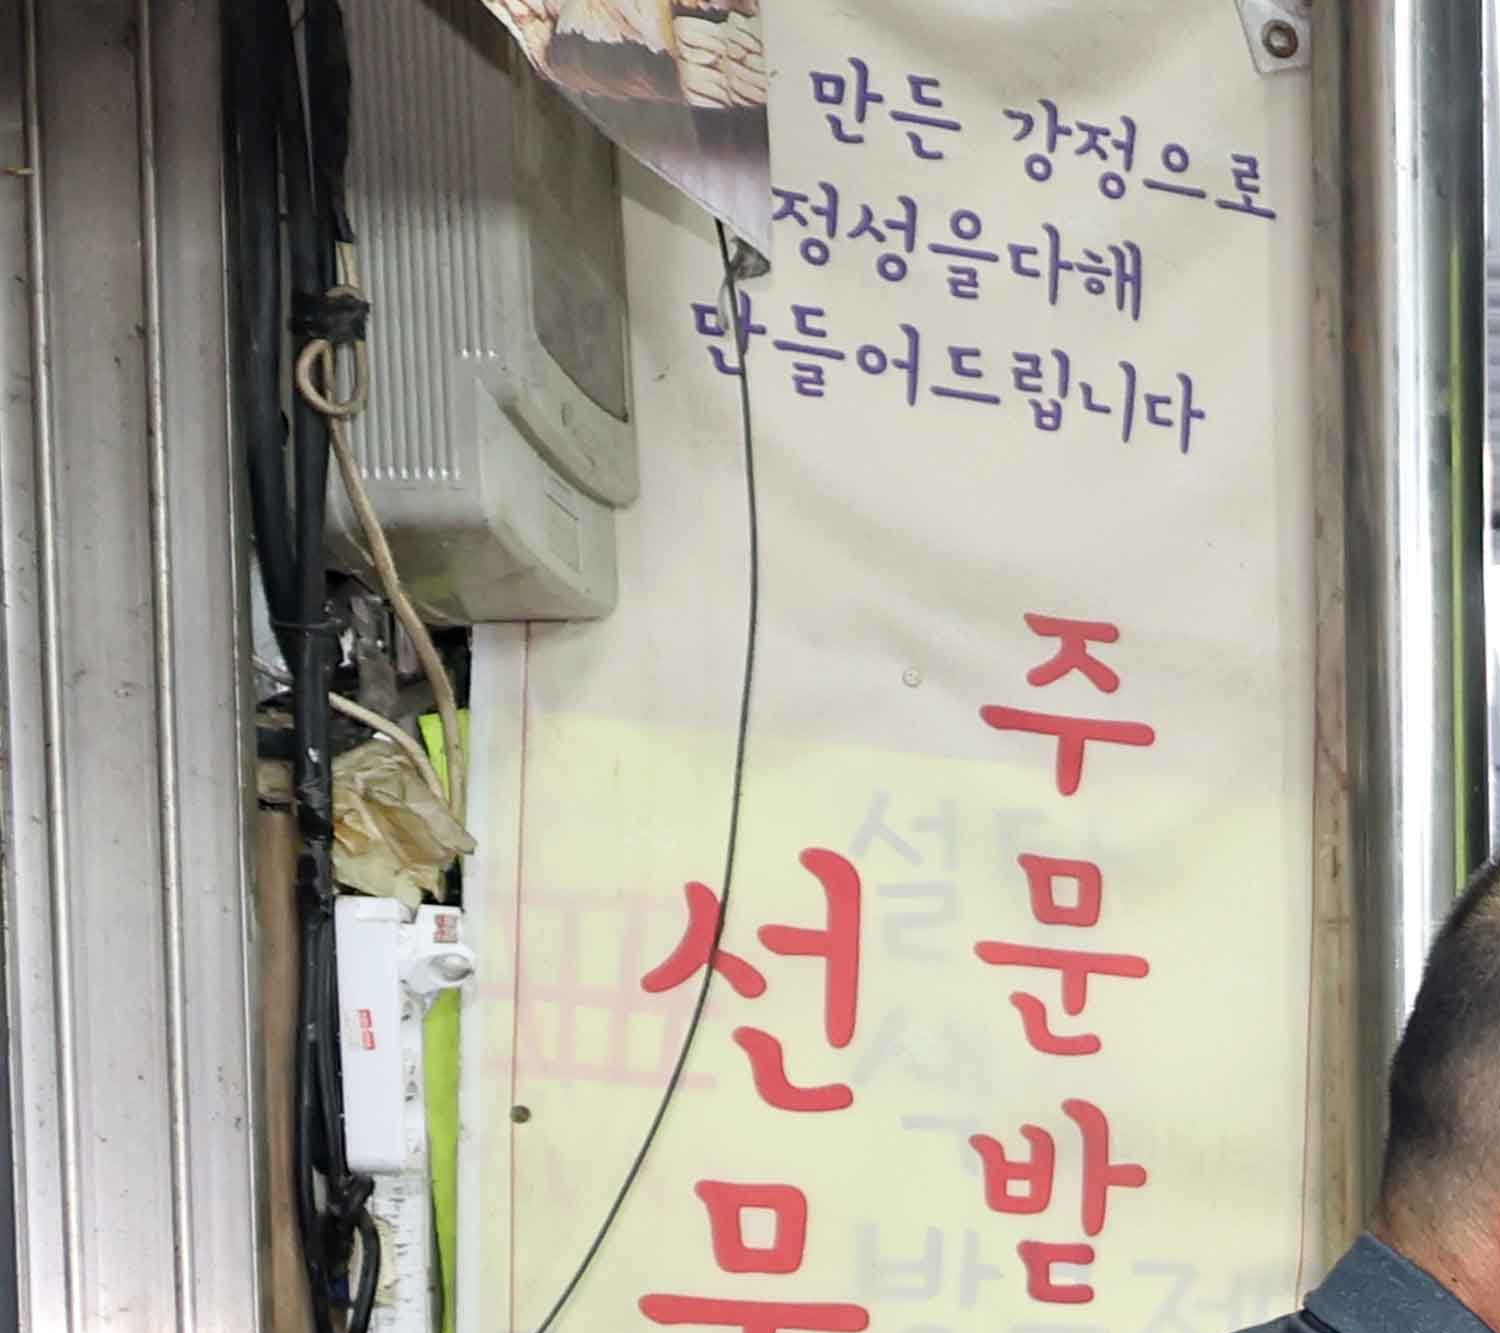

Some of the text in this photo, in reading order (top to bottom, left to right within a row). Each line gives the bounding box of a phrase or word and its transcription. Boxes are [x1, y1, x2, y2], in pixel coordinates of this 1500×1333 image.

[810, 57, 1277, 220] 만든 강정으로
[691, 289, 1206, 454] 만들어드립니다
